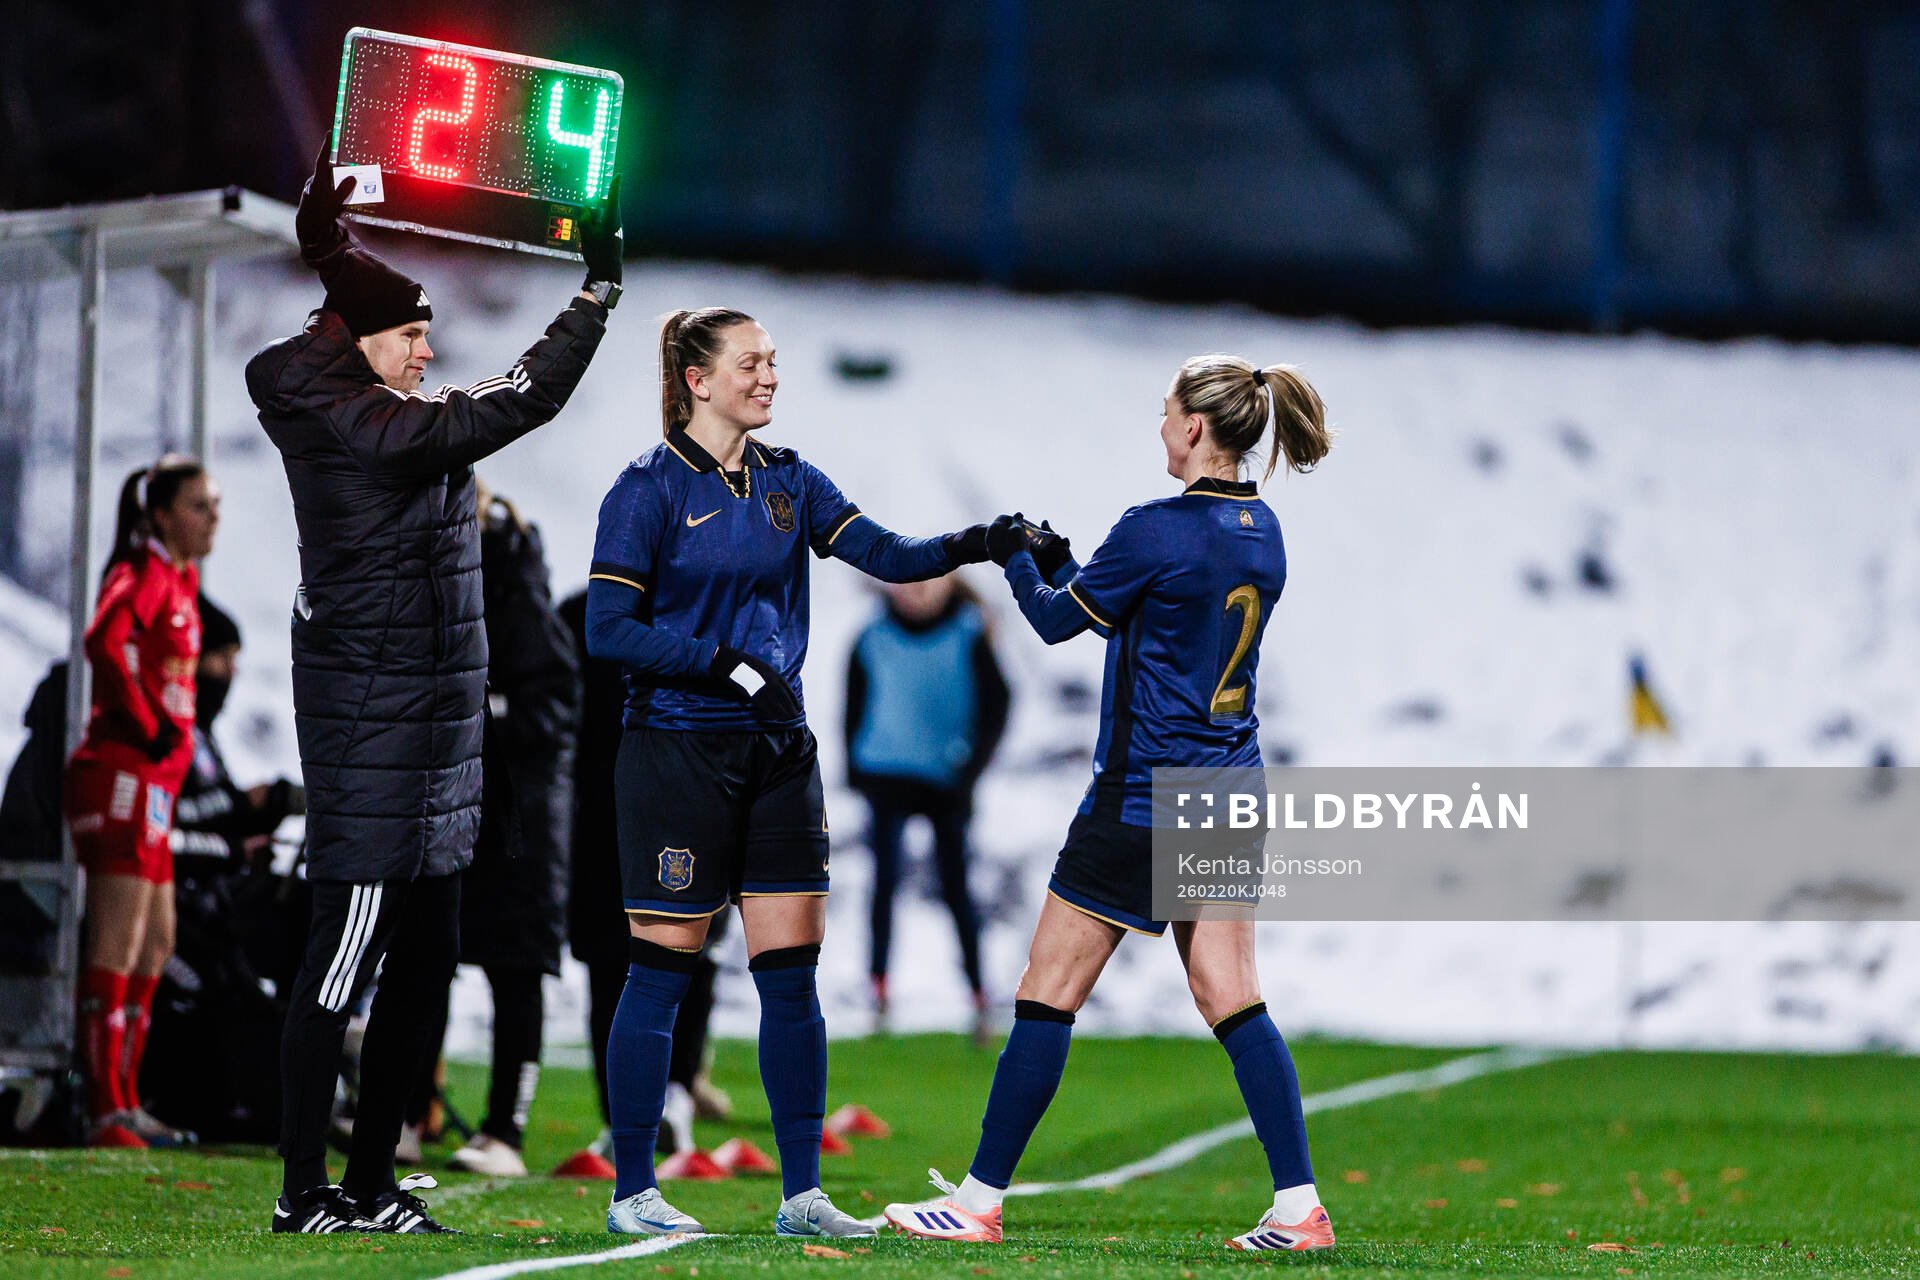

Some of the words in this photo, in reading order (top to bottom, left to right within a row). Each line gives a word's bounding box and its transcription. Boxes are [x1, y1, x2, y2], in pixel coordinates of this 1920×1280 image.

[410, 54, 477, 179] 2
[548, 80, 610, 199] 4
[1210, 584, 1261, 715] 2
